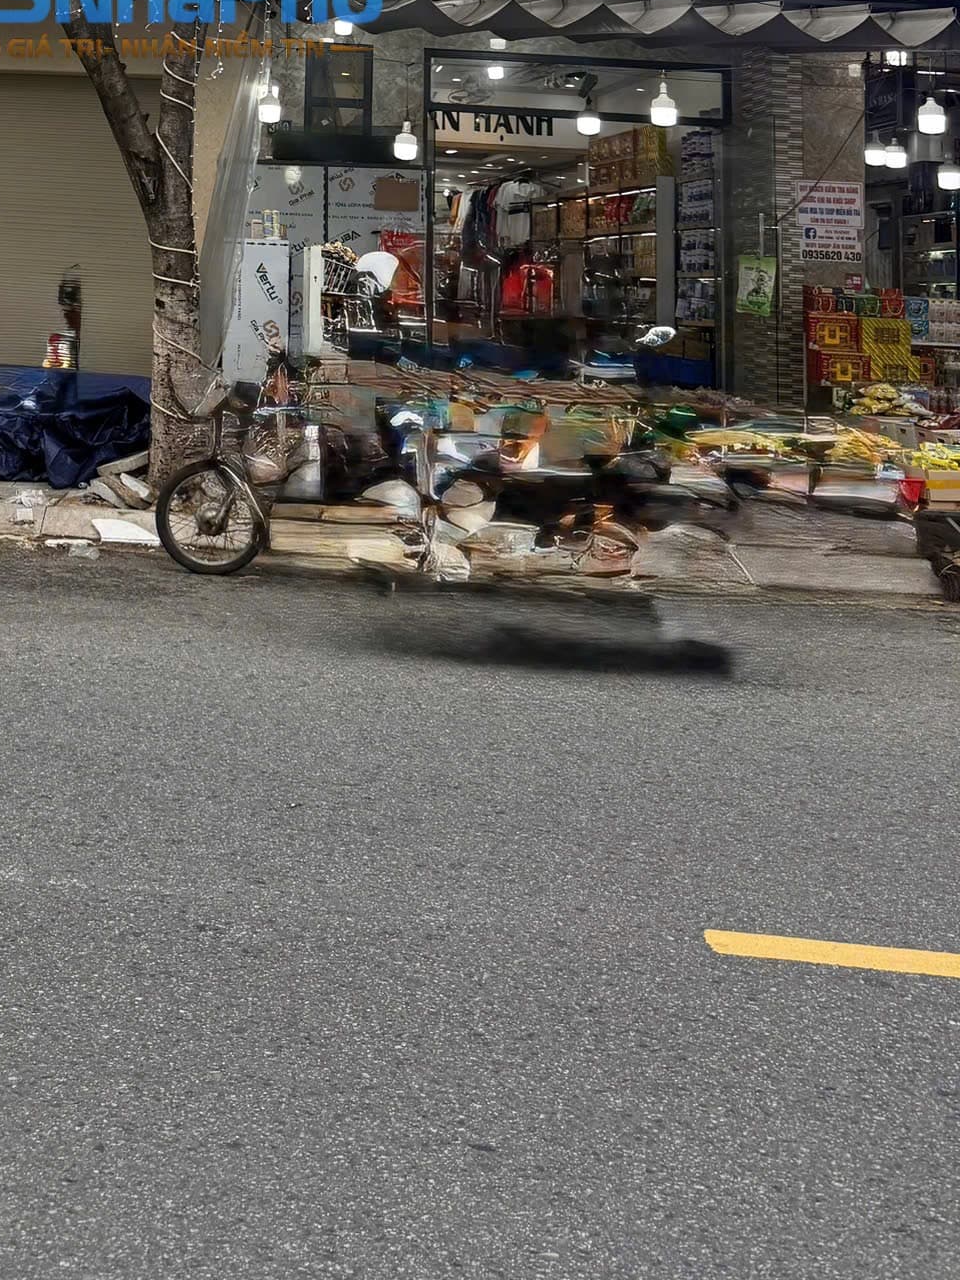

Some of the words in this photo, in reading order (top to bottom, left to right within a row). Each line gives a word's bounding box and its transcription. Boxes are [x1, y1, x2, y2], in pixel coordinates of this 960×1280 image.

[801, 249, 843, 261] 0935620
[843, 251, 862, 262] 430
[255, 262, 279, 301] Vertu
